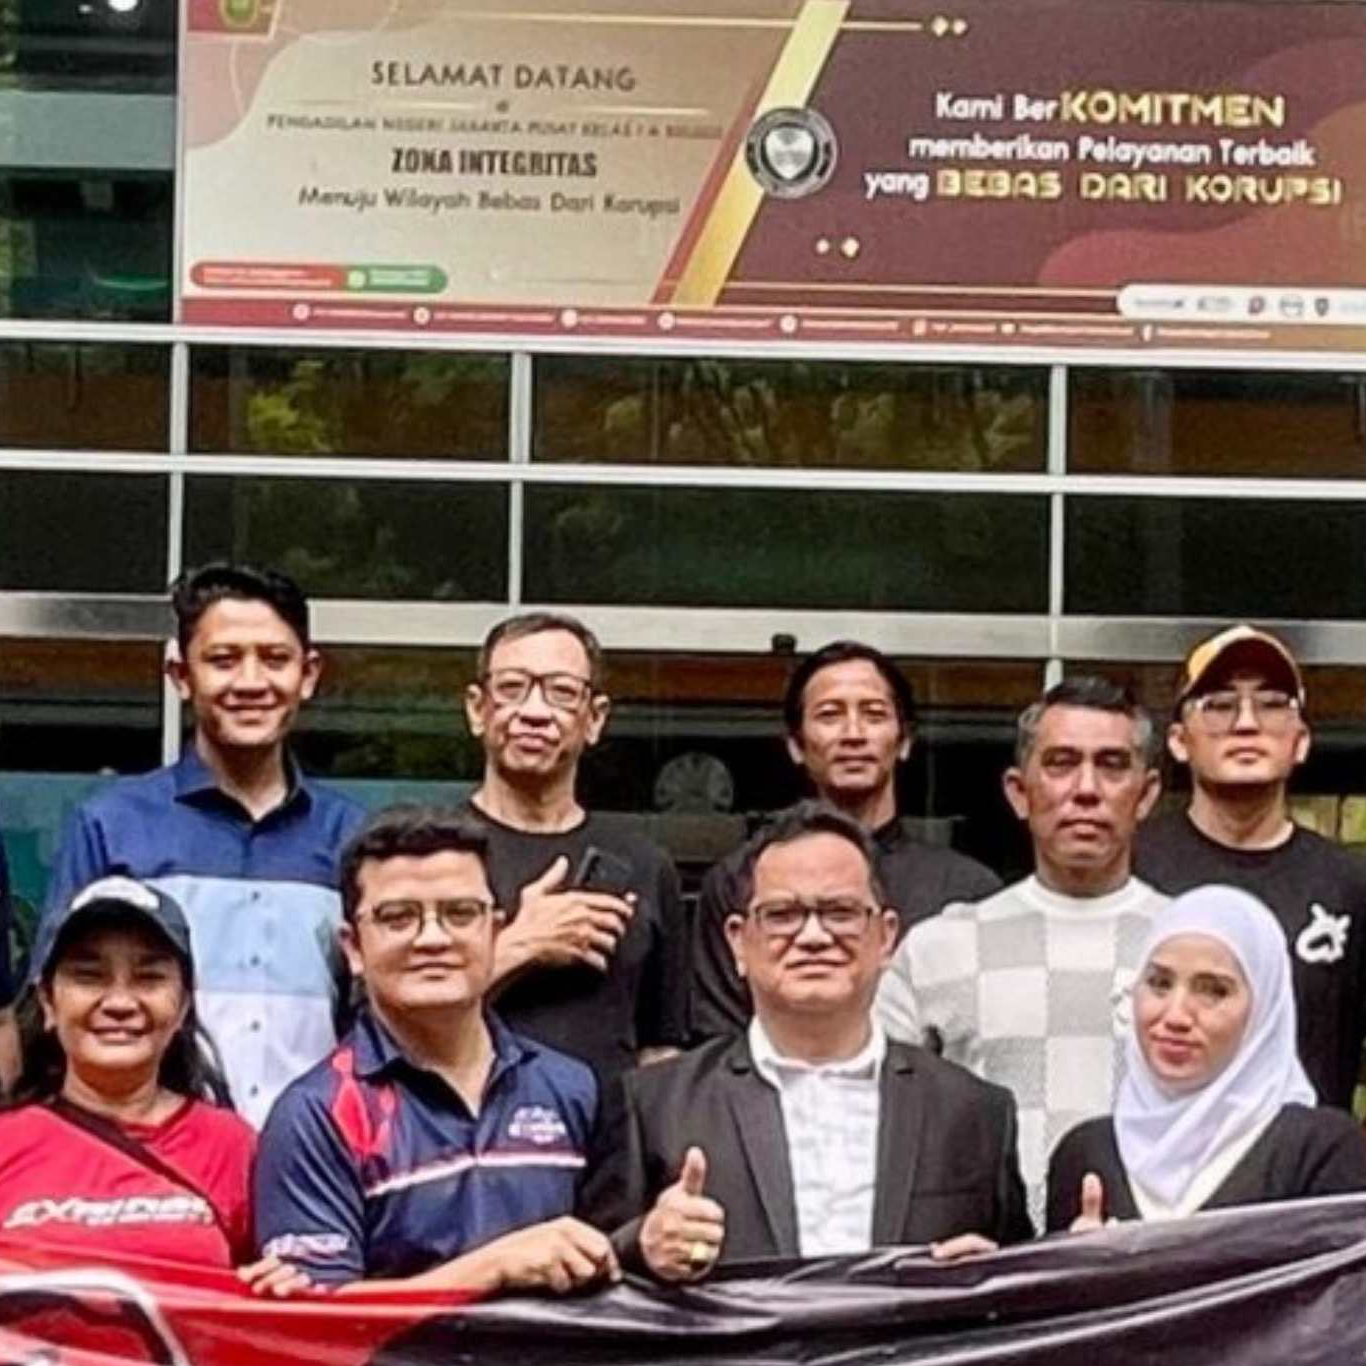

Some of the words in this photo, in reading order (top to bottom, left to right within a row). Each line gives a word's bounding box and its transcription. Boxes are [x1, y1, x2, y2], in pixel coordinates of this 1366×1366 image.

[371, 60, 502, 88] SELAMAT
[514, 64, 636, 92] DATANG
[936, 91, 1003, 121] Kami
[391, 147, 453, 174] ZONA
[459, 150, 598, 177] INTEGRITAS
[908, 133, 1069, 160] memberikan
[1077, 136, 1211, 168] Pelayanan
[1219, 138, 1316, 166] Terbaik
[298, 186, 377, 212] Menuju
[383, 188, 472, 214] Wilayah
[478, 193, 542, 211] Bebas
[550, 193, 595, 213] Dari
[864, 171, 930, 200] yang
[936, 169, 1062, 198] BEBAS
[1080, 172, 1167, 201] DARI
[1185, 174, 1342, 205] KORUPSI
